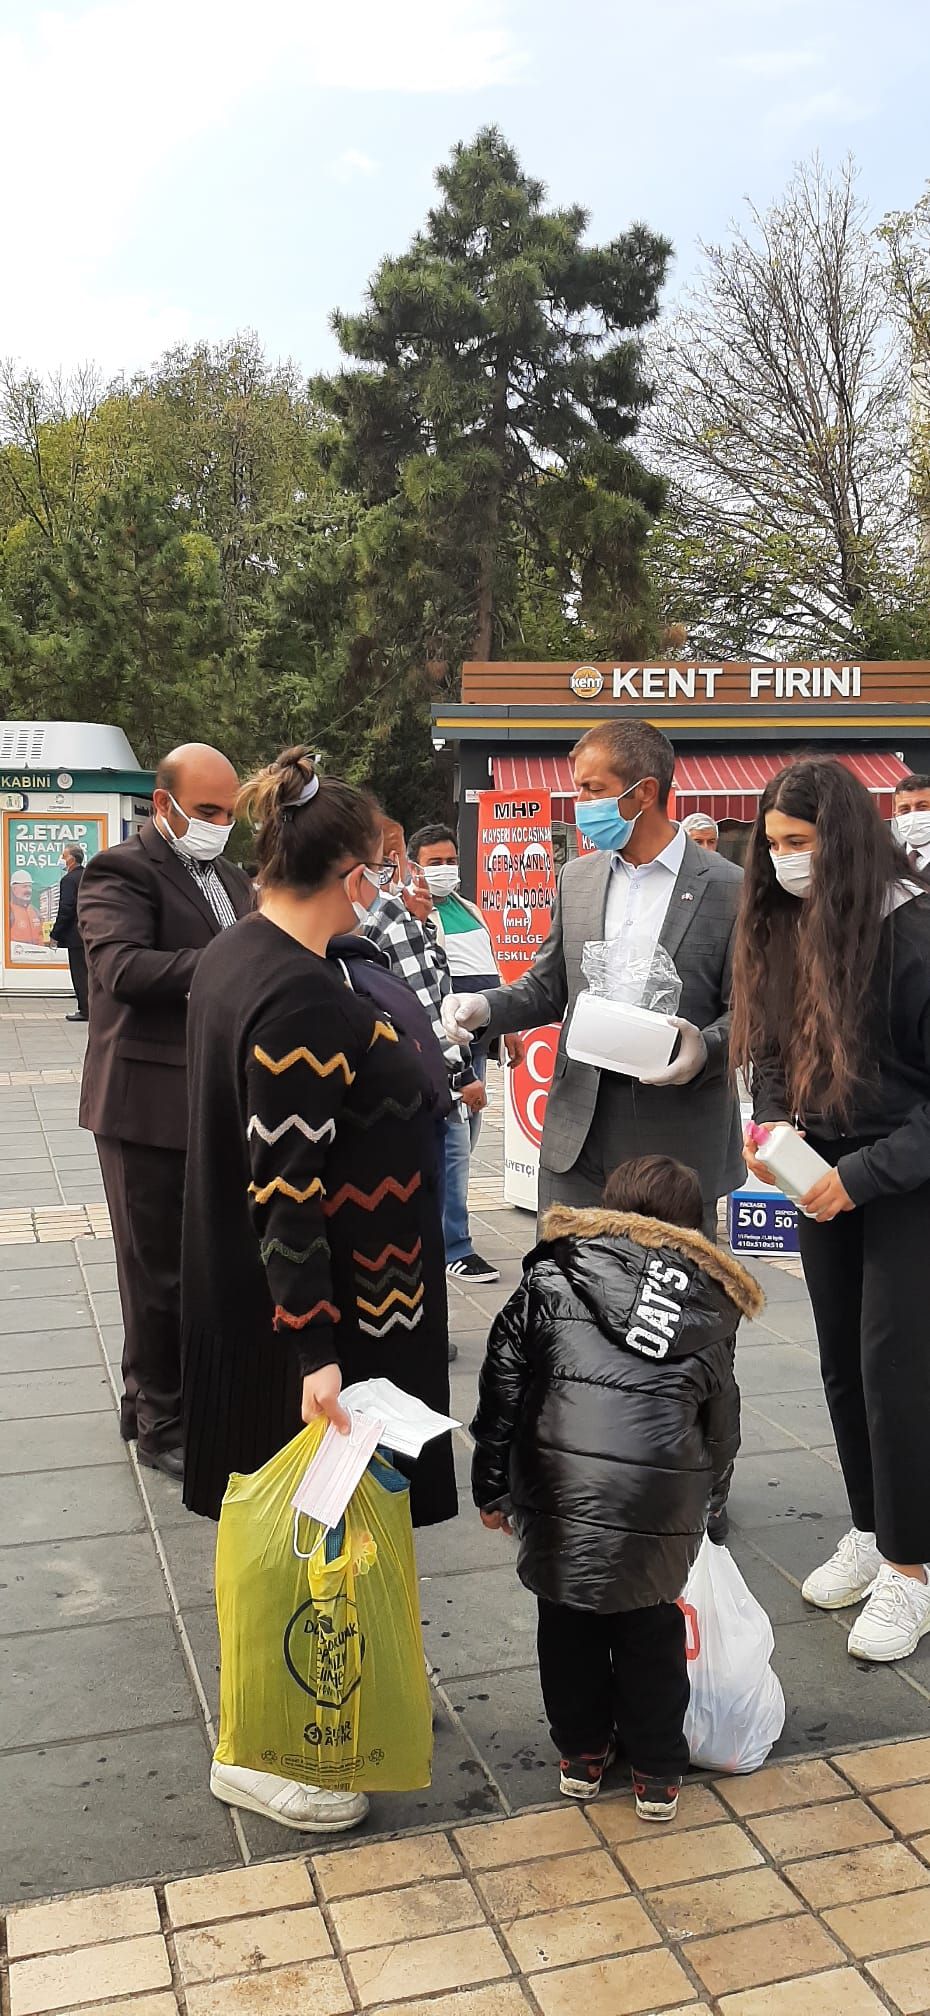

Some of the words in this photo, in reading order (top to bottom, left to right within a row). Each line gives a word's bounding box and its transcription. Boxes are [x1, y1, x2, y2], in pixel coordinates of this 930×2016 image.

[612, 668, 724, 698] KENT
[750, 667, 863, 697] FIRINI
[1, 774, 51, 788] KABİNİ
[494, 802, 540, 819] MHP
[15, 824, 87, 841] 2.ETAP
[15, 841, 88, 854] İNŞAATR
[506, 917, 530, 927] MHP
[737, 1208, 767, 1228] 50
[774, 1216, 793, 1228] 50
